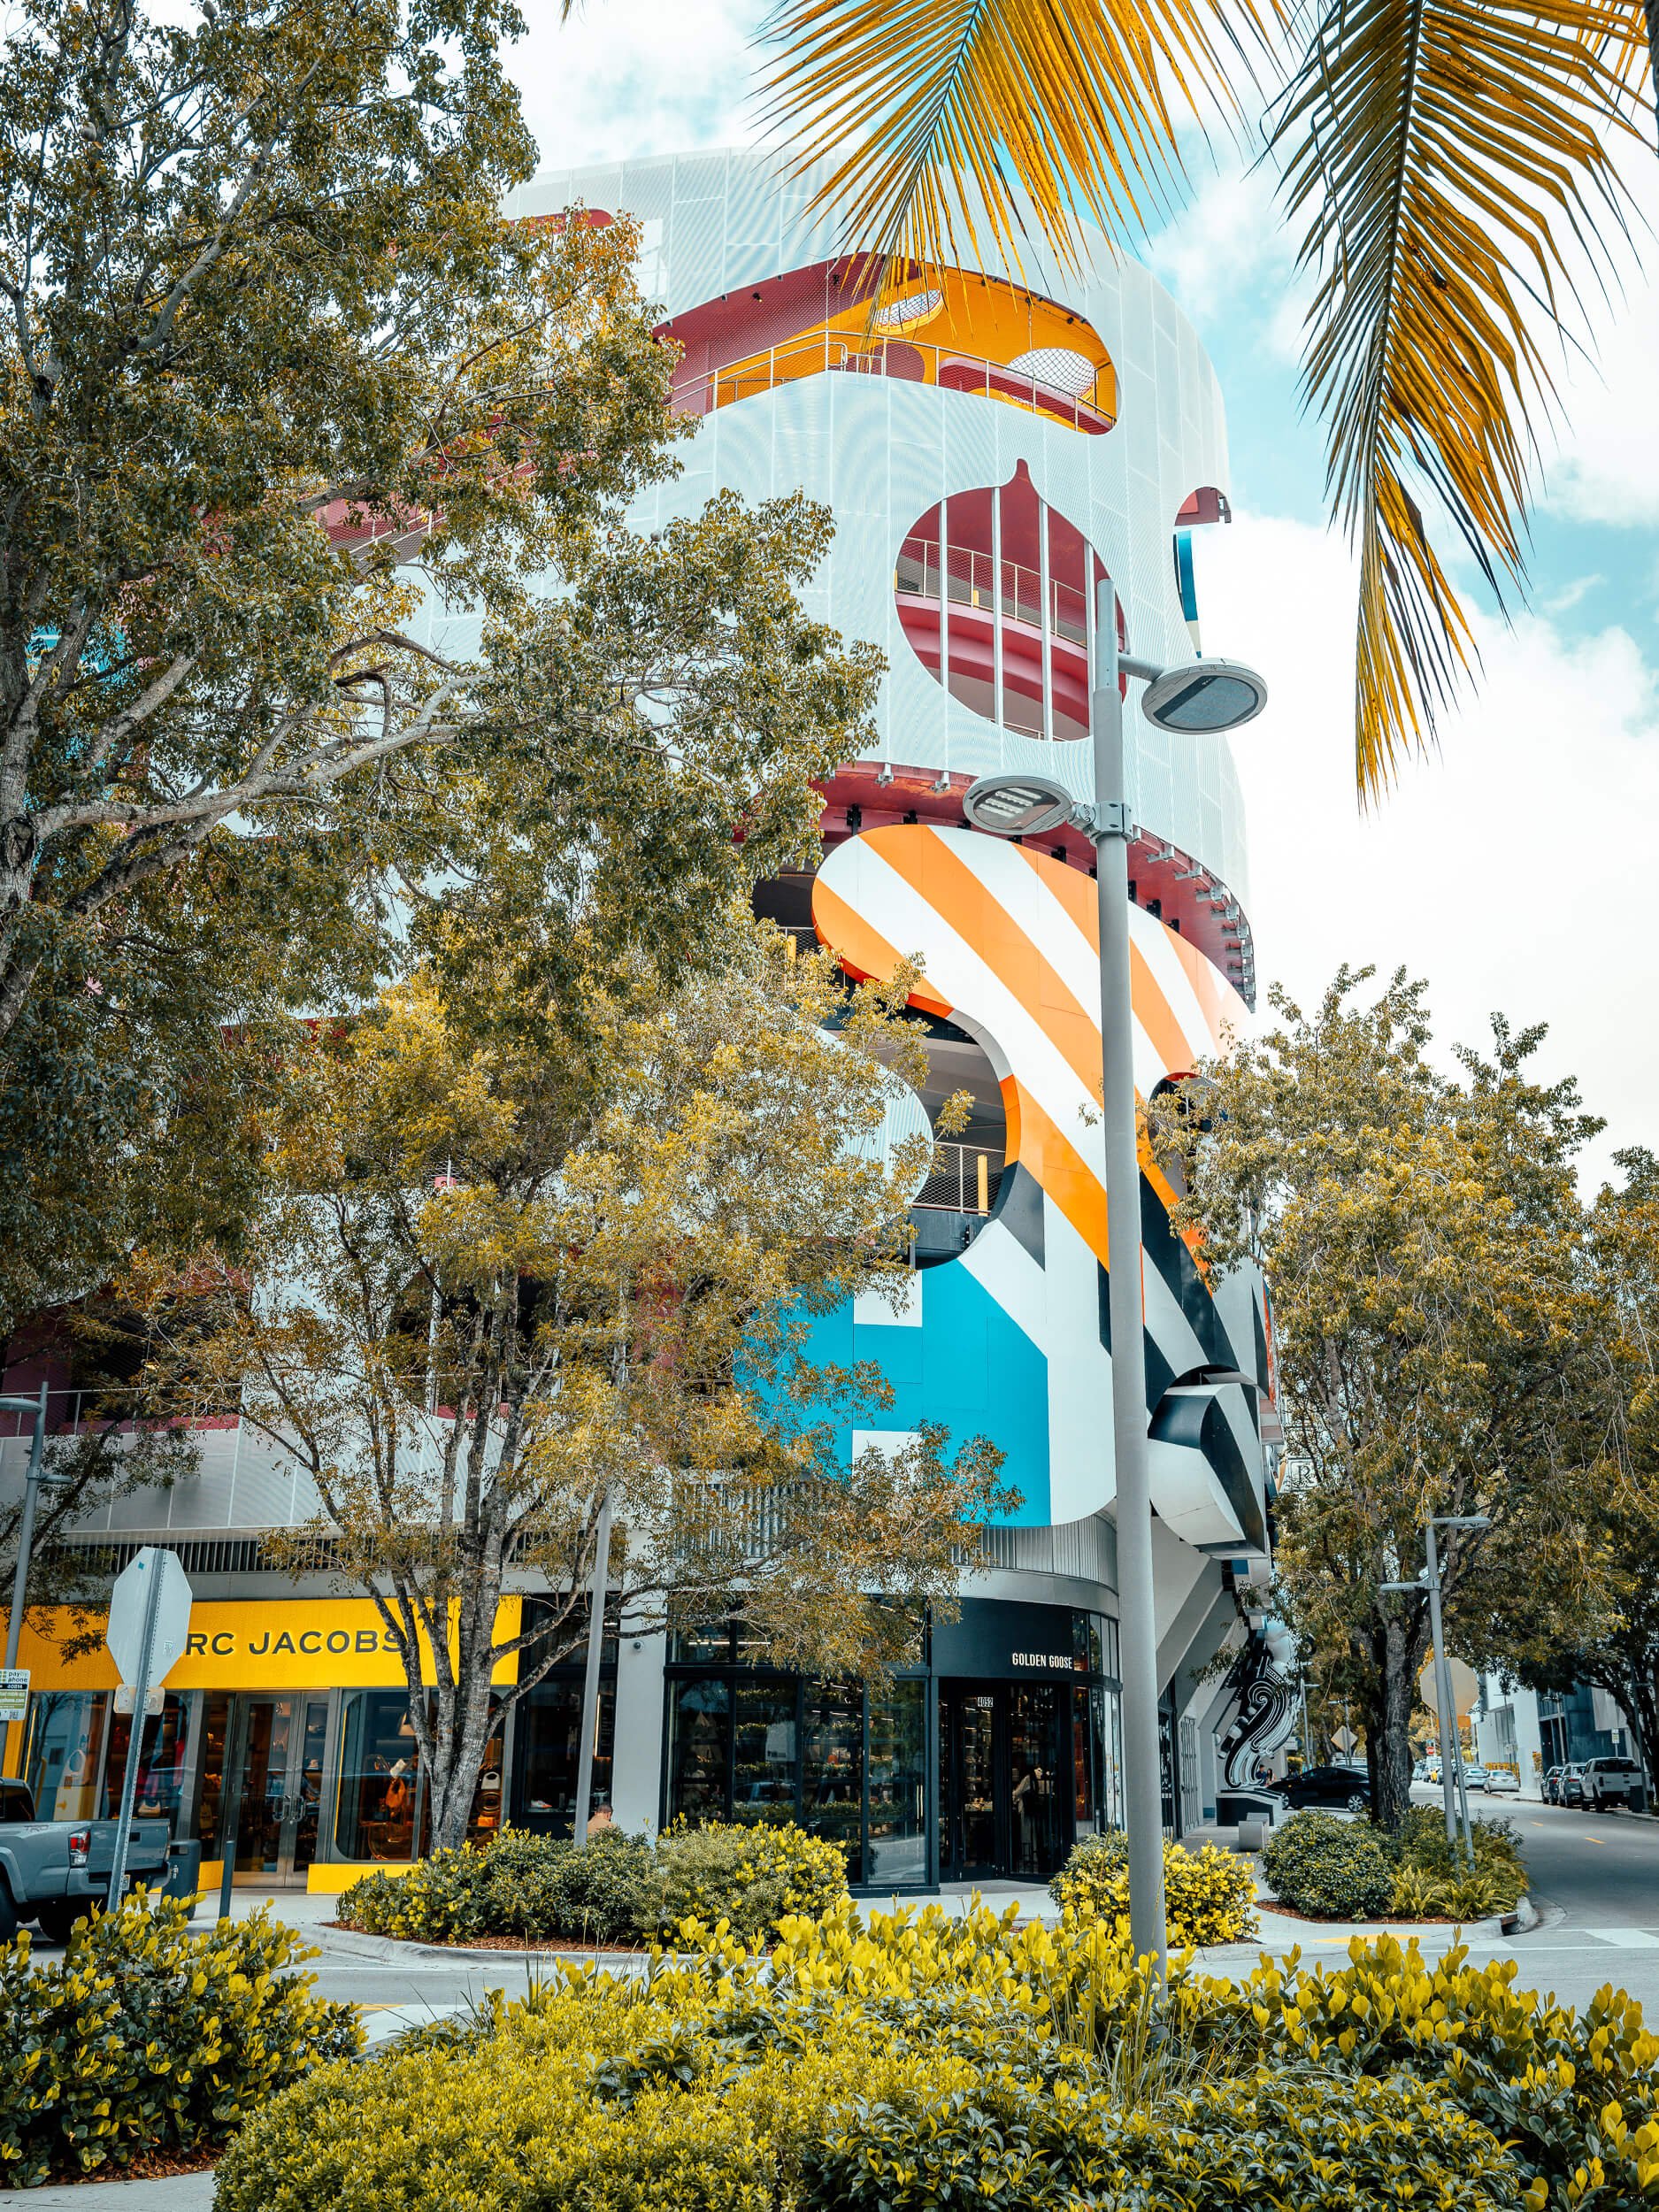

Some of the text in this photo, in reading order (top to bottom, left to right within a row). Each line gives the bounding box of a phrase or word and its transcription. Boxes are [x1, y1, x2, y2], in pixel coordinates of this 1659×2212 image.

[186, 1631, 404, 1655] RC JACOBS
[1012, 1653, 1073, 1669] GOLDEN GOOSE
[978, 1697, 993, 1707] 4052
